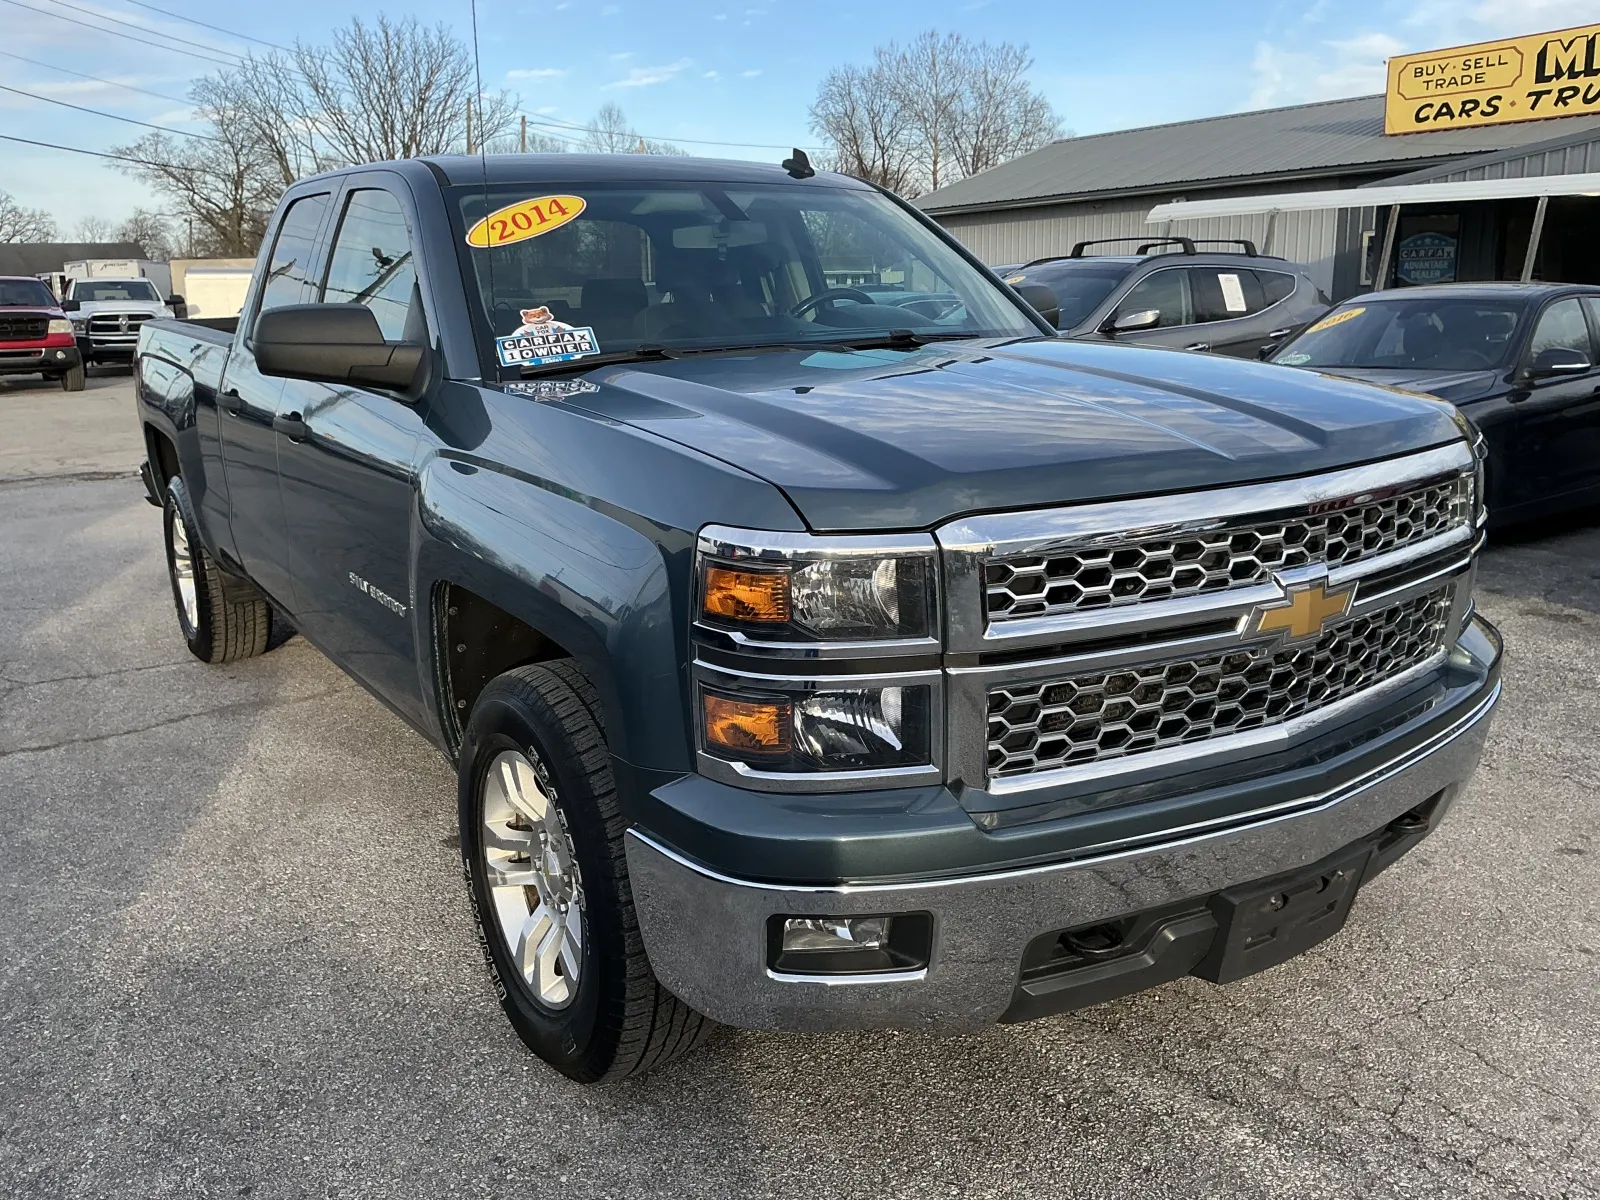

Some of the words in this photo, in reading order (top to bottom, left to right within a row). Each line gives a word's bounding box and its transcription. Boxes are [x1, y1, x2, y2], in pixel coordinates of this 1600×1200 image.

[1413, 62, 1450, 78] BUY
[1461, 55, 1509, 71] SELL
[1423, 72, 1486, 91] TRADE
[1414, 95, 1503, 124] CARS
[490, 199, 570, 241] 2014
[1401, 248, 1453, 259] CARFAX
[1403, 261, 1449, 270] ADVANTAGE
[1410, 270, 1441, 279] DEALER
[503, 333, 589, 350] CARFAX
